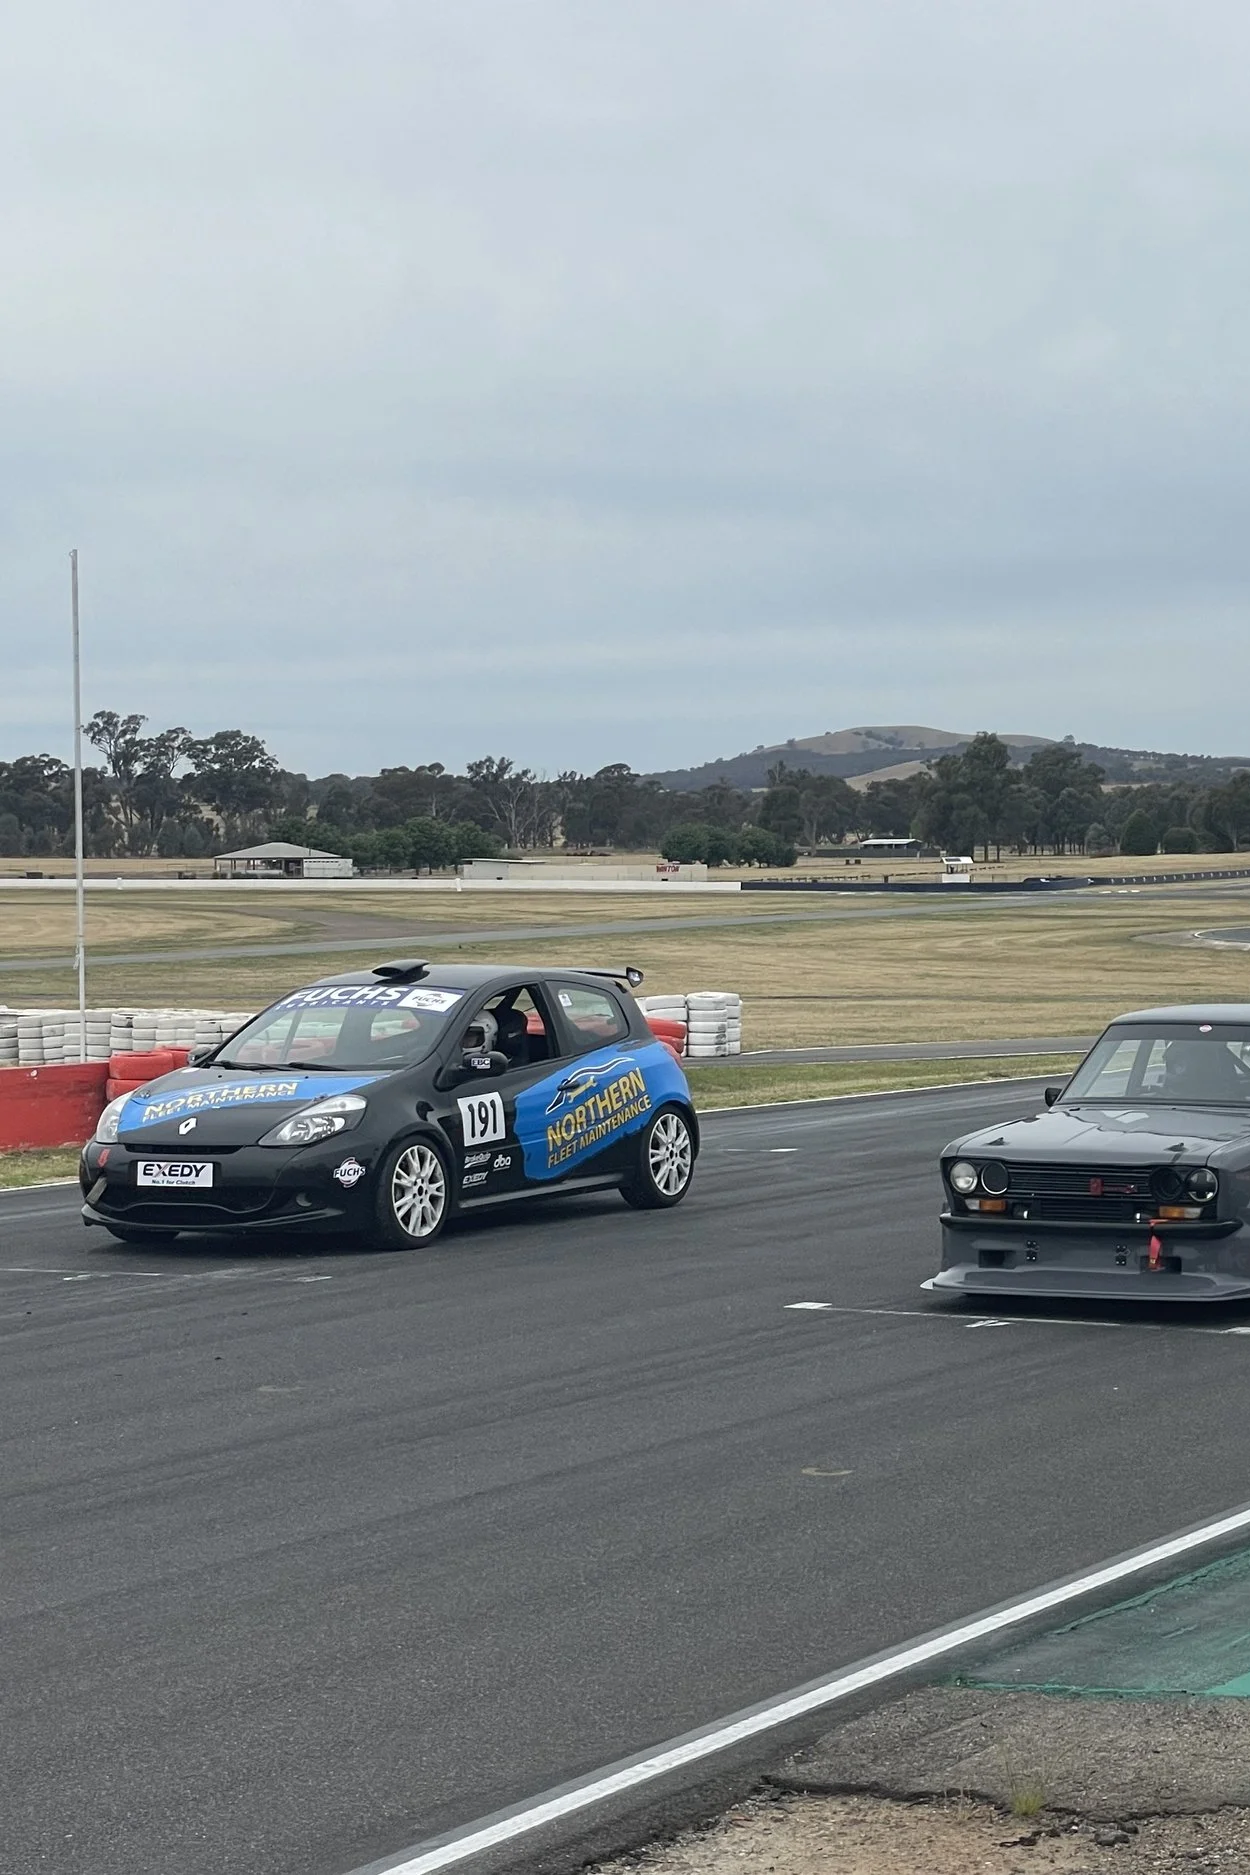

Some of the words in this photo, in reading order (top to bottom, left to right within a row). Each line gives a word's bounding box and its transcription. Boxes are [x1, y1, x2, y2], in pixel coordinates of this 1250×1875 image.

[277, 986, 410, 1005] FUCHS
[411, 995, 445, 1004] FUCHS
[142, 1105, 181, 1123] FLEET
[188, 1090, 296, 1109] MAINTENANCE
[144, 1082, 298, 1116] NORTHERN
[546, 1066, 646, 1152] NORTHERN
[467, 1098, 498, 1139] 191
[547, 1139, 578, 1169] FLEET
[579, 1094, 652, 1150] MAINTENANCE
[142, 1163, 207, 1178] EXEDY
[333, 1166, 366, 1178] FUCHS
